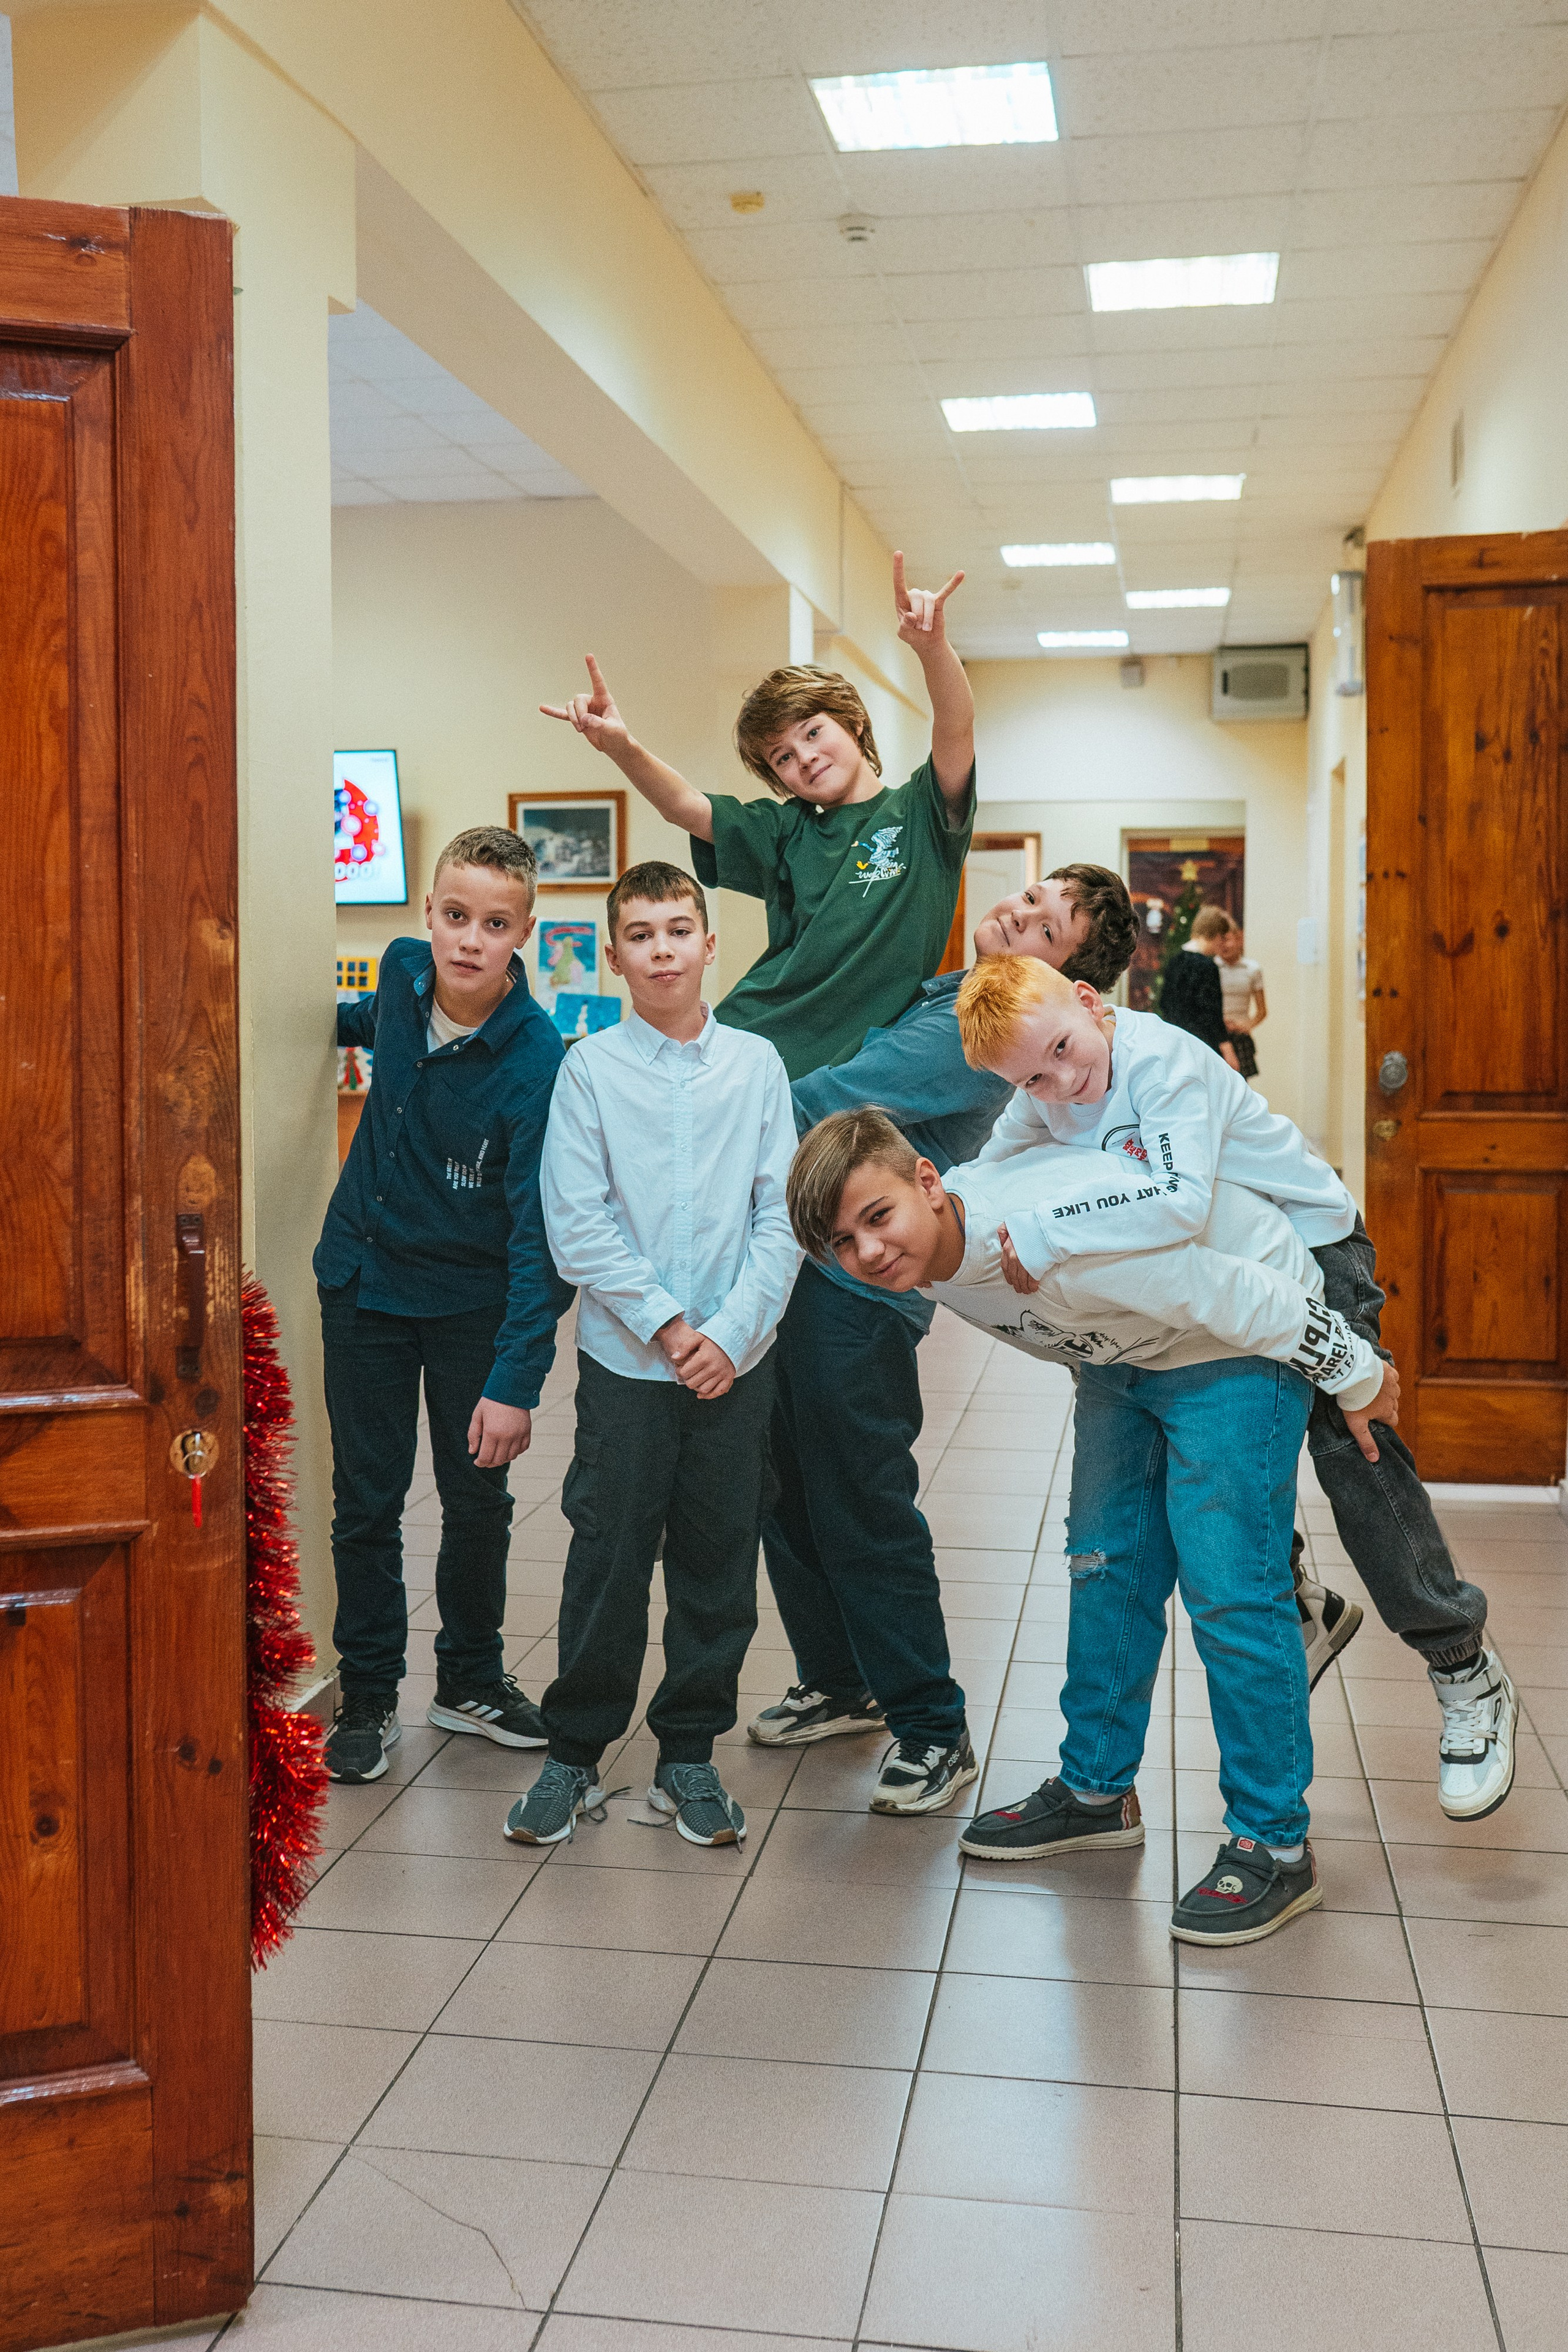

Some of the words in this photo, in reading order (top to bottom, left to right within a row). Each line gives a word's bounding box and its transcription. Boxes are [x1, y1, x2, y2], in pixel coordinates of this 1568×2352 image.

[481, 1139, 489, 1150] HEART
[1136, 1186, 1167, 1200] HAT
[1096, 1193, 1131, 1209] YOU
[1052, 1202, 1090, 1218] LIKE
